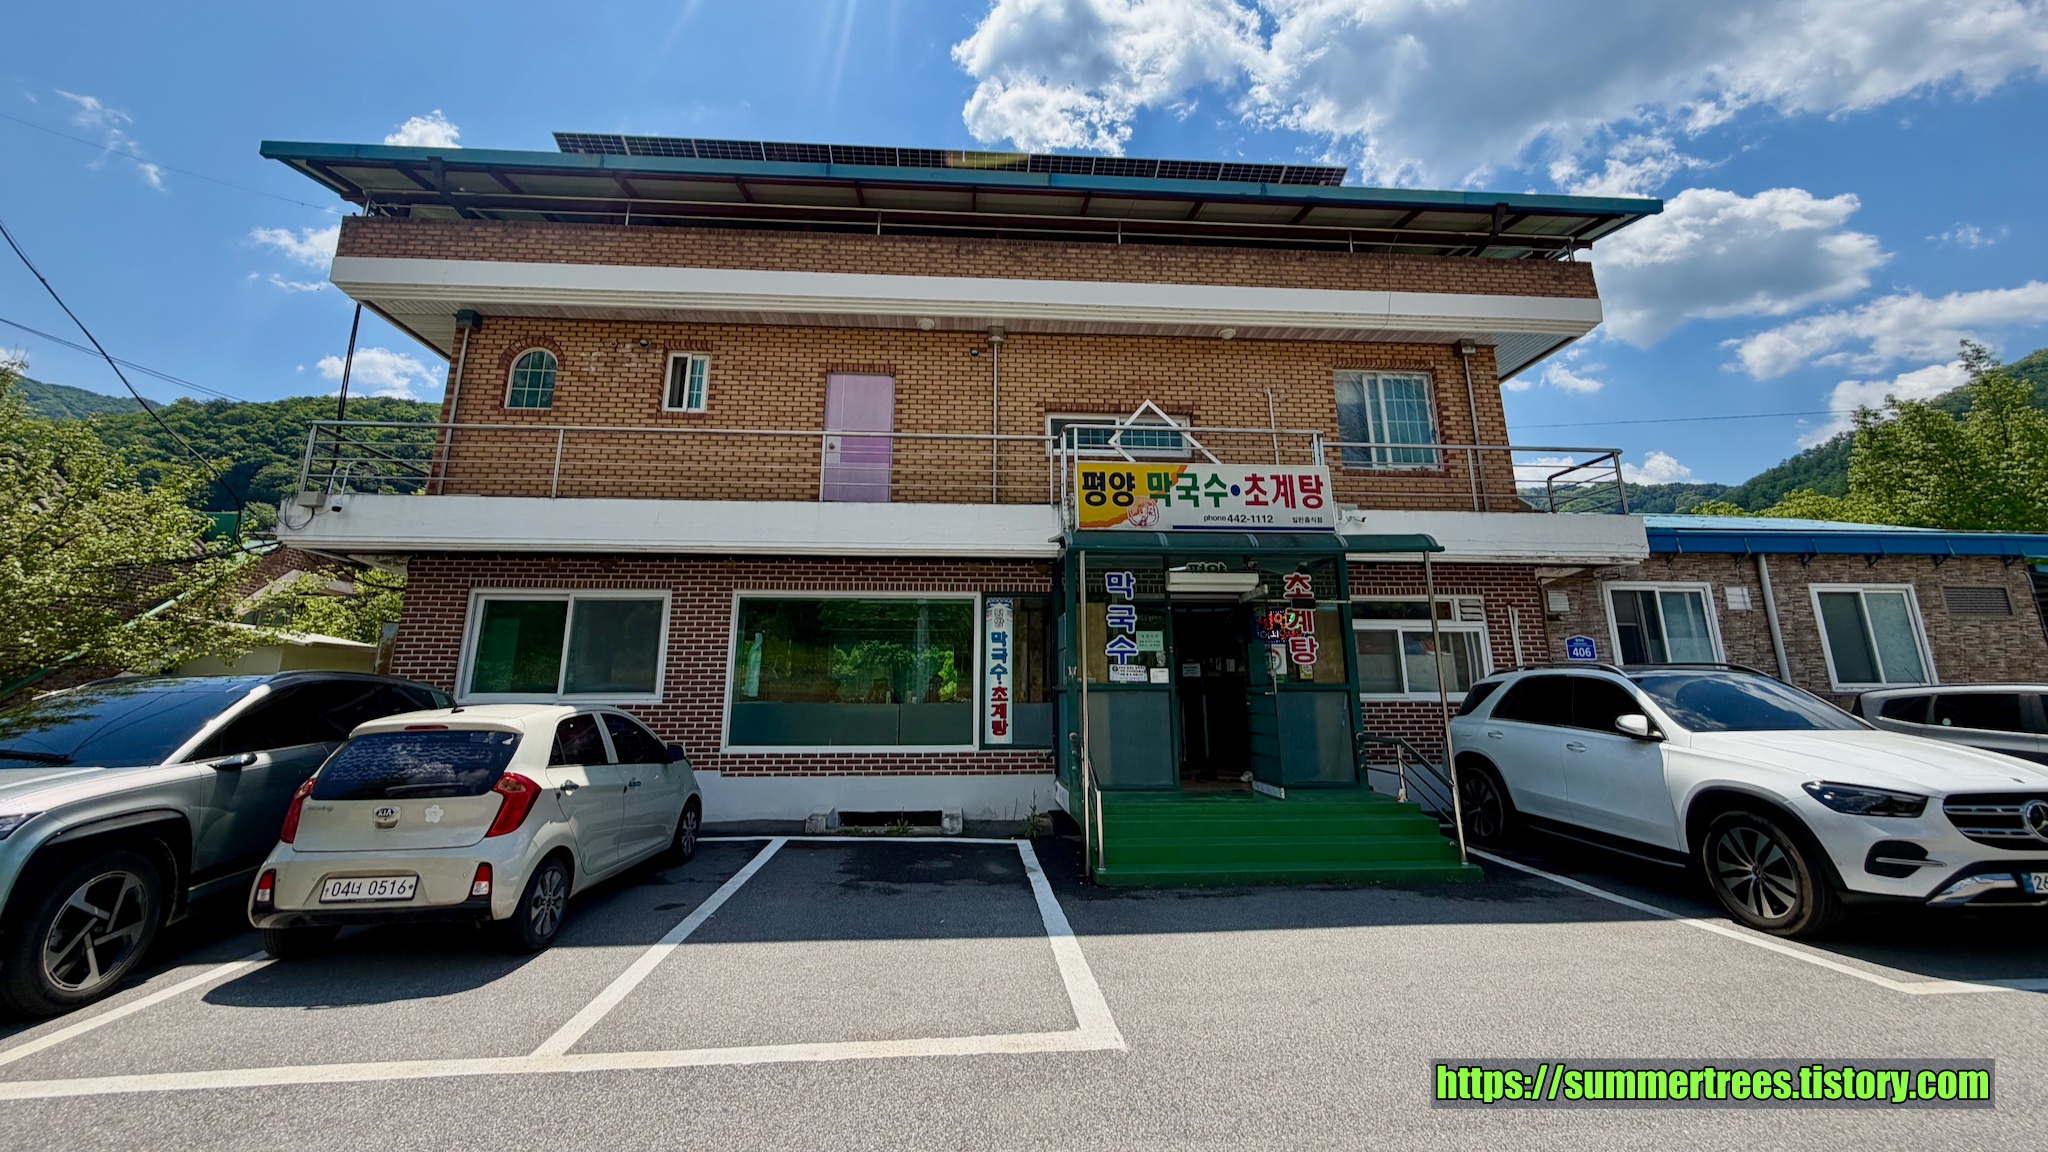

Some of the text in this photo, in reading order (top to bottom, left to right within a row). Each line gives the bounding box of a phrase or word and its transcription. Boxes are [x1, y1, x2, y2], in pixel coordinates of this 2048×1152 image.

[1082, 471, 1136, 507] 평양
[1203, 514, 1274, 524] phone 442-1112
[1105, 571, 1139, 665] 막국수
[1283, 572, 1319, 665] 초계탕
[1572, 647, 1592, 657] 406
[377, 808, 394, 817] KIA
[331, 880, 407, 897] 04너 0516
